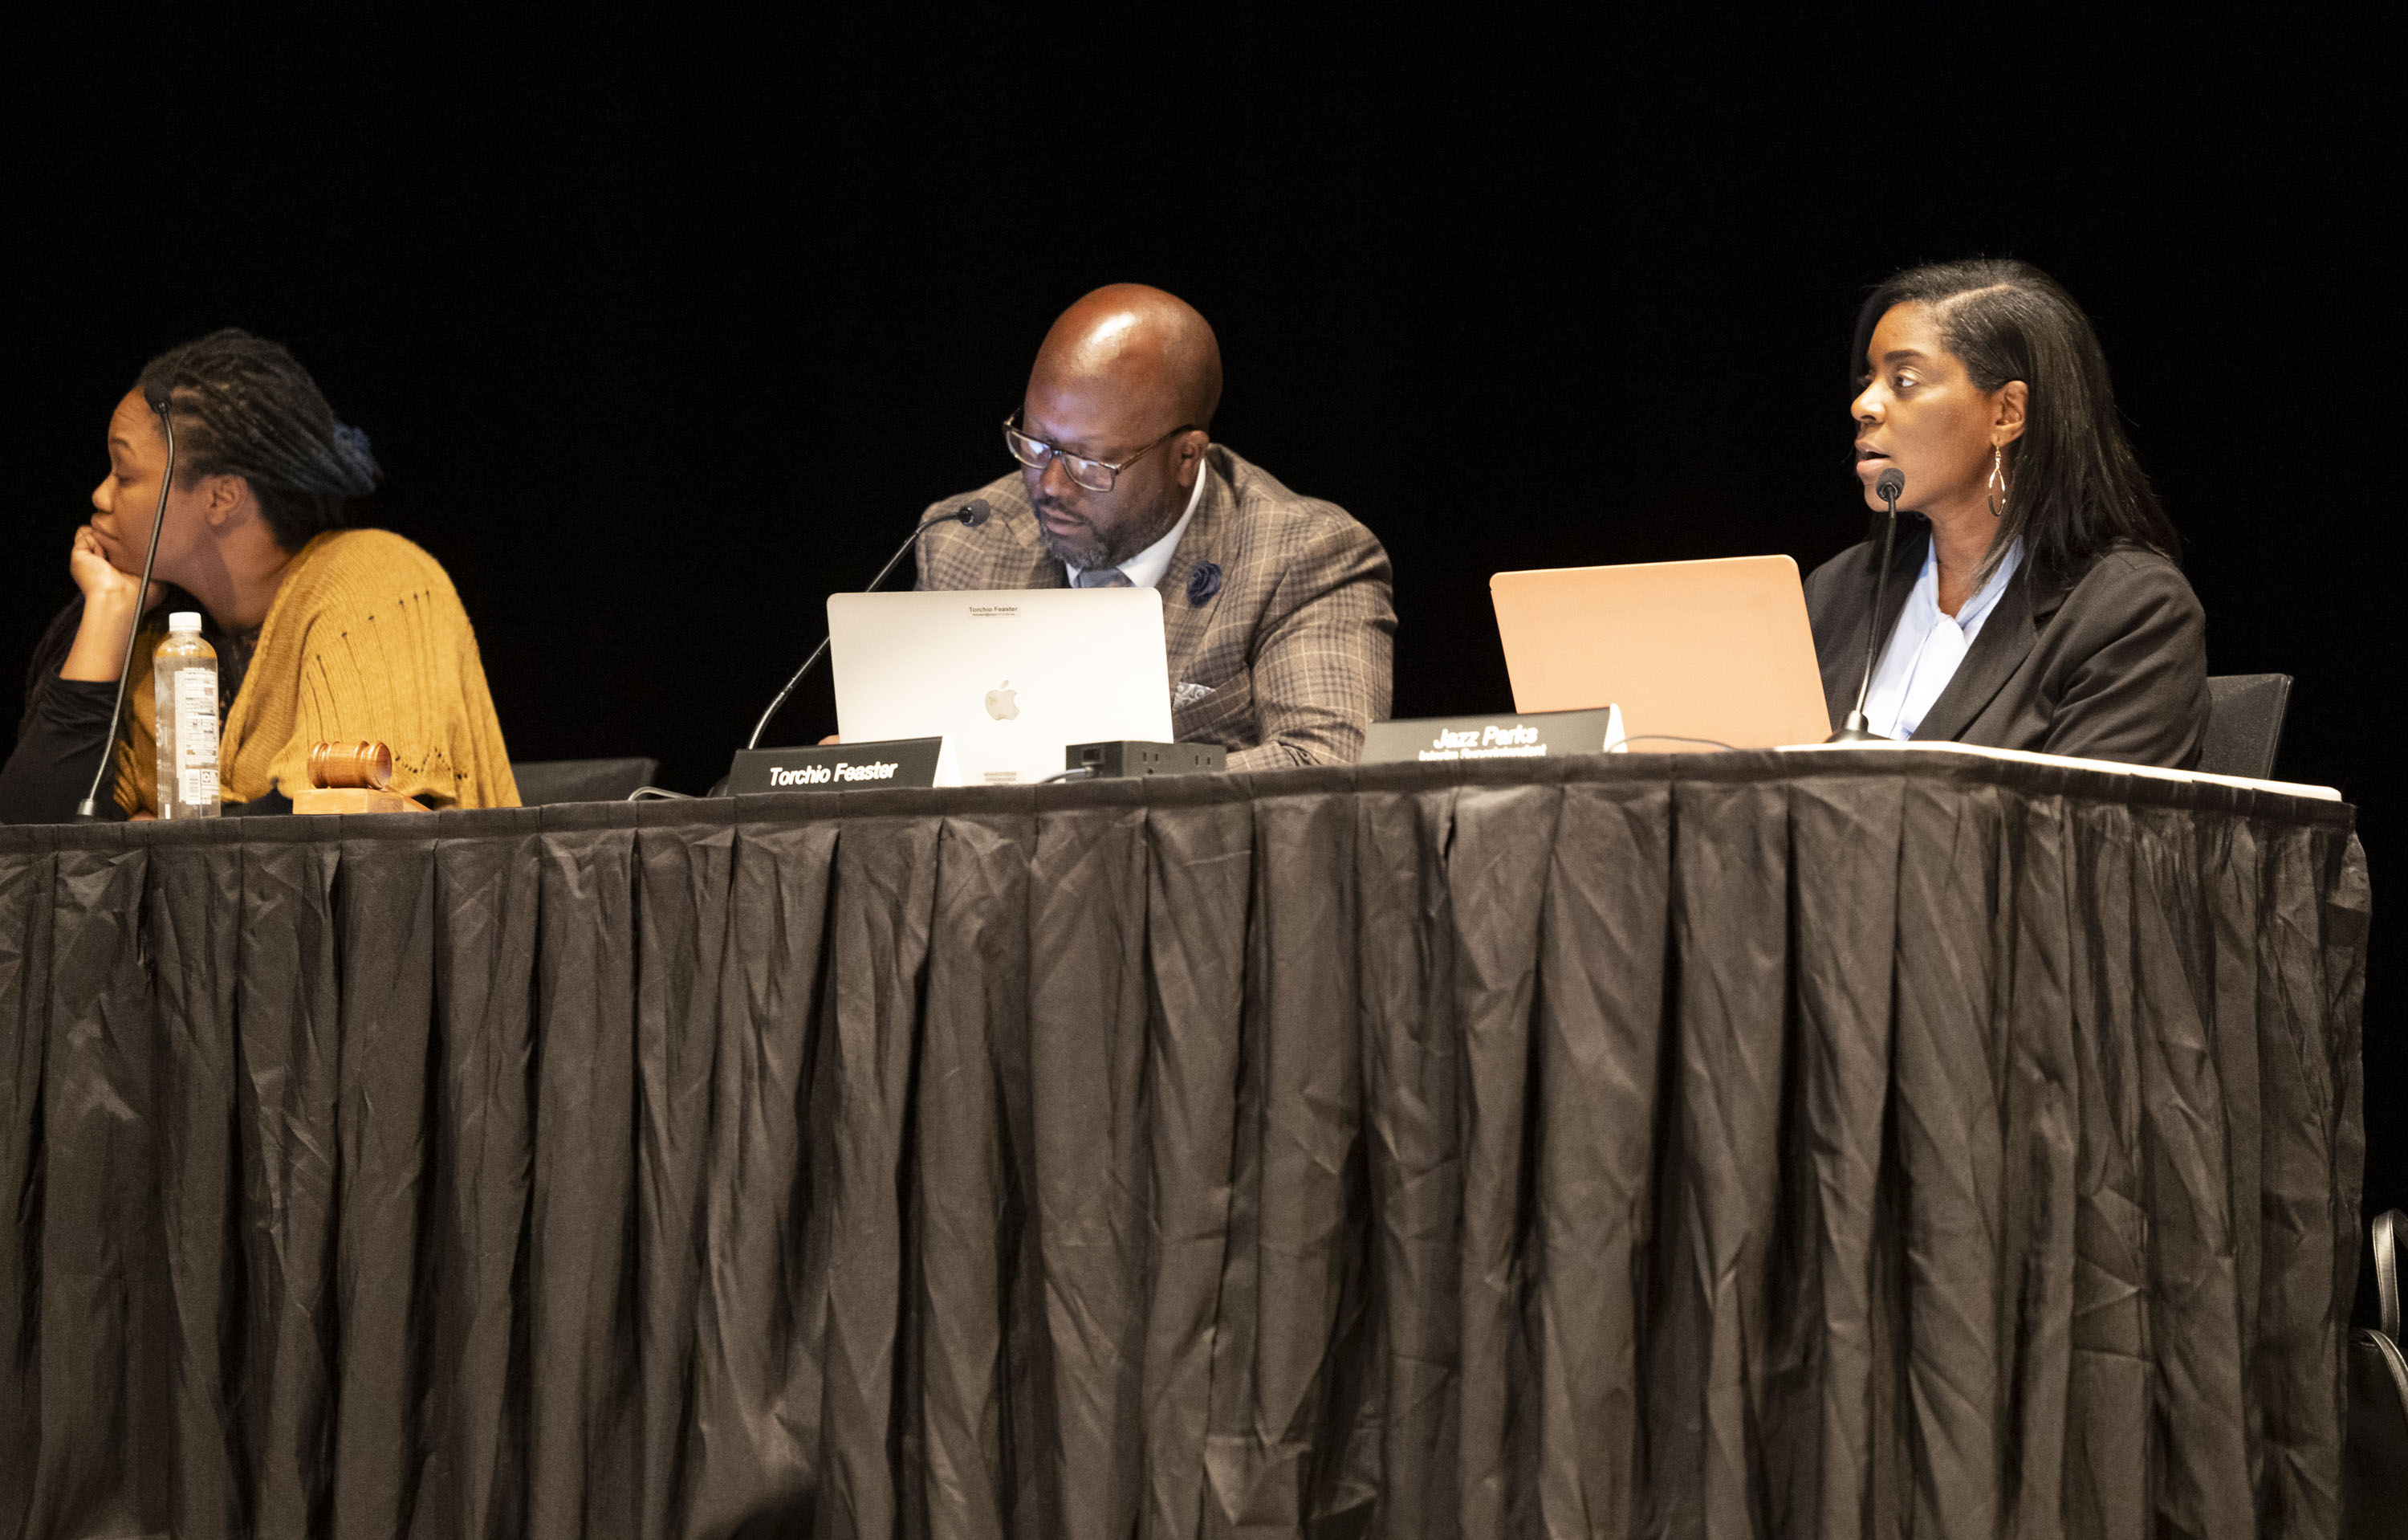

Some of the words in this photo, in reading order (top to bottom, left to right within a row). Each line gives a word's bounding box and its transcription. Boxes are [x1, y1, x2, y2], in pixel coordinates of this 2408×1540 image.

[1434, 728, 1480, 749] Jazz
[1482, 724, 1539, 746] Parks
[770, 764, 831, 786] Torchio
[833, 761, 899, 782] Feaster
